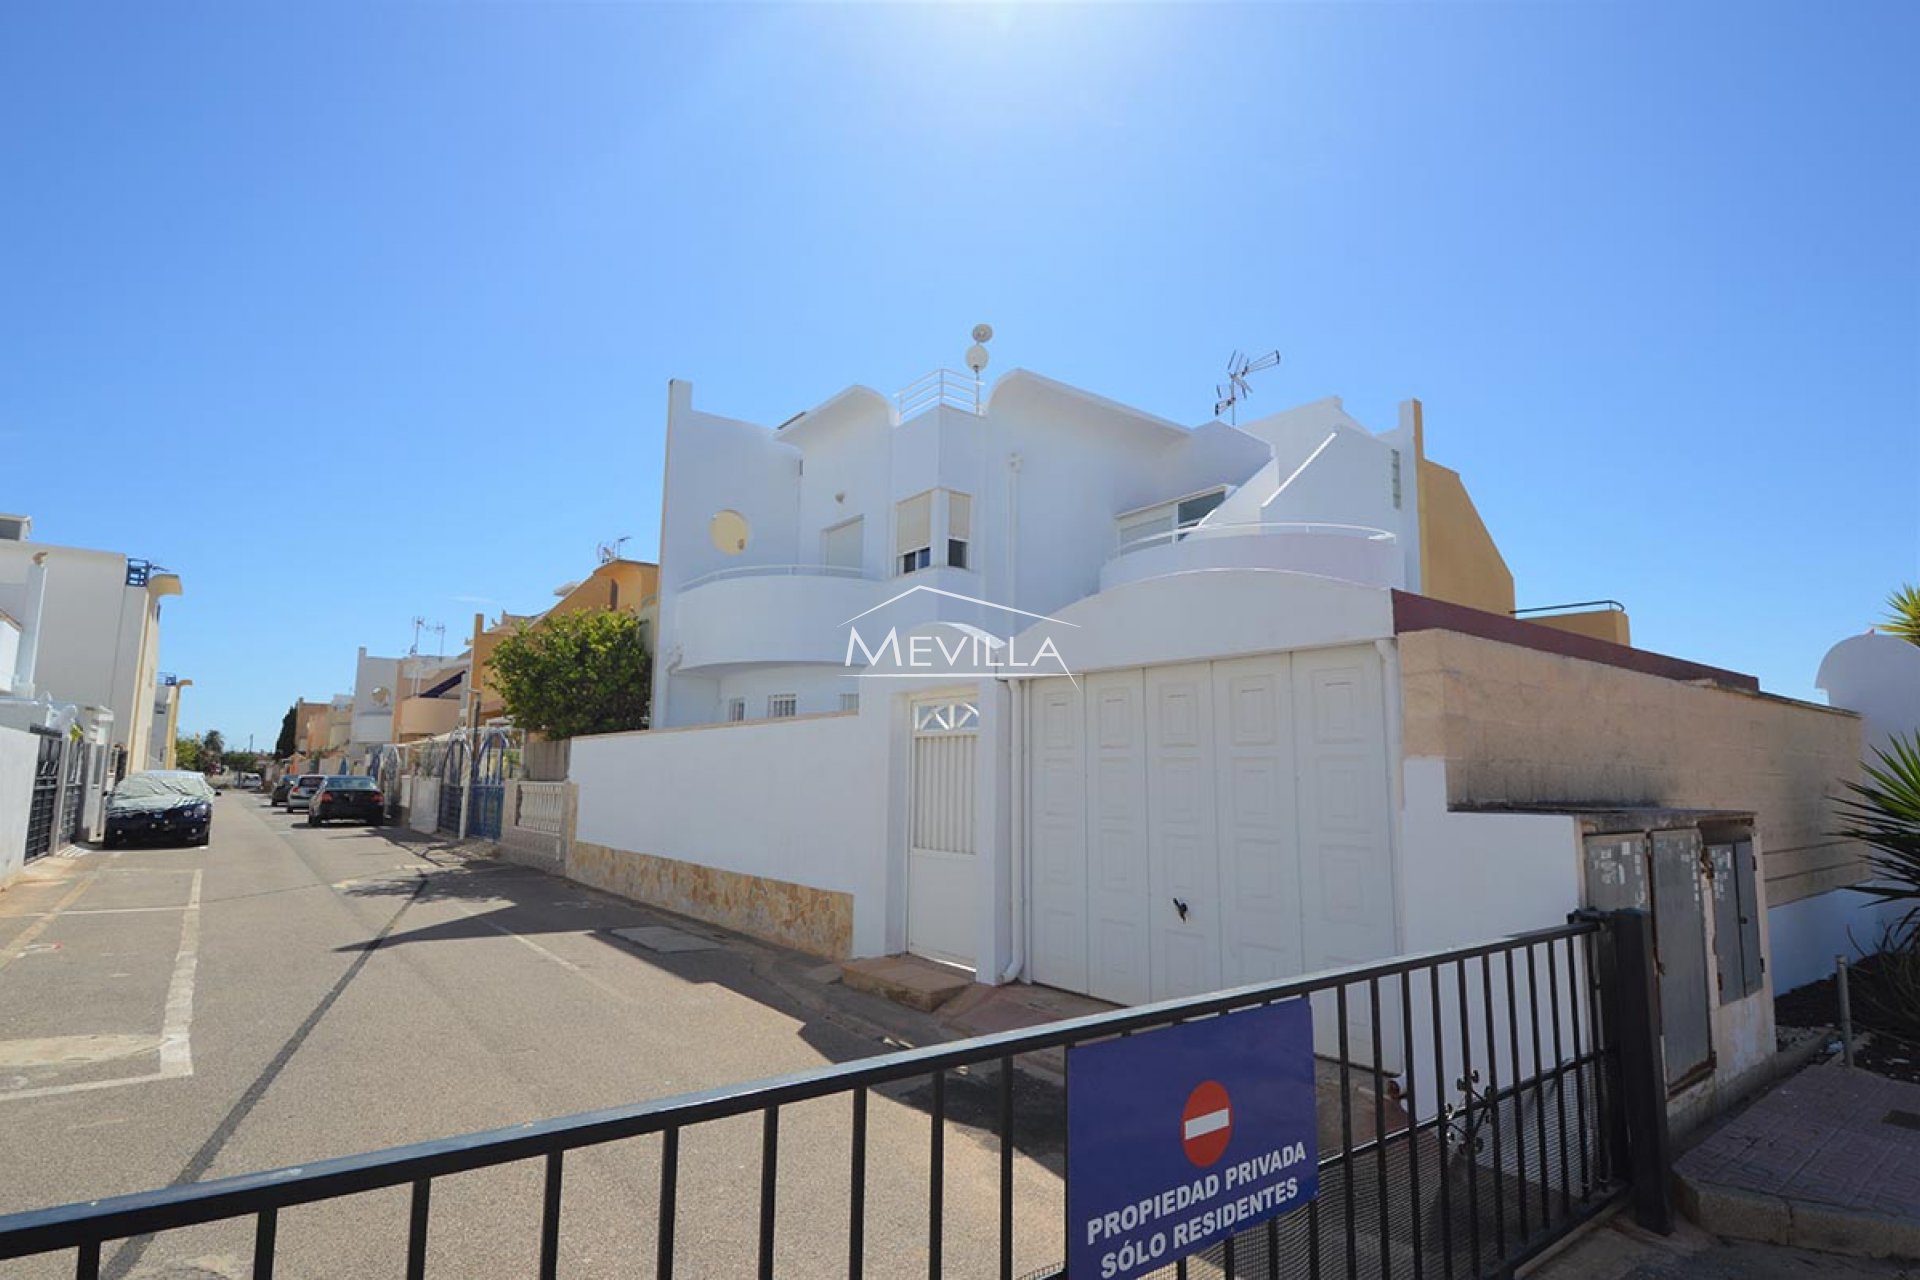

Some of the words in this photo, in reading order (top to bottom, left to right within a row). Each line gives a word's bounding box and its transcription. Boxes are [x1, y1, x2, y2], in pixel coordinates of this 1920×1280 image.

[1087, 1174, 1219, 1245] PROPIEDAD
[1226, 1141, 1306, 1190] PRIVADA
[1101, 1232, 1166, 1279] SÓLO
[1174, 1177, 1298, 1248] RESIDENTES
